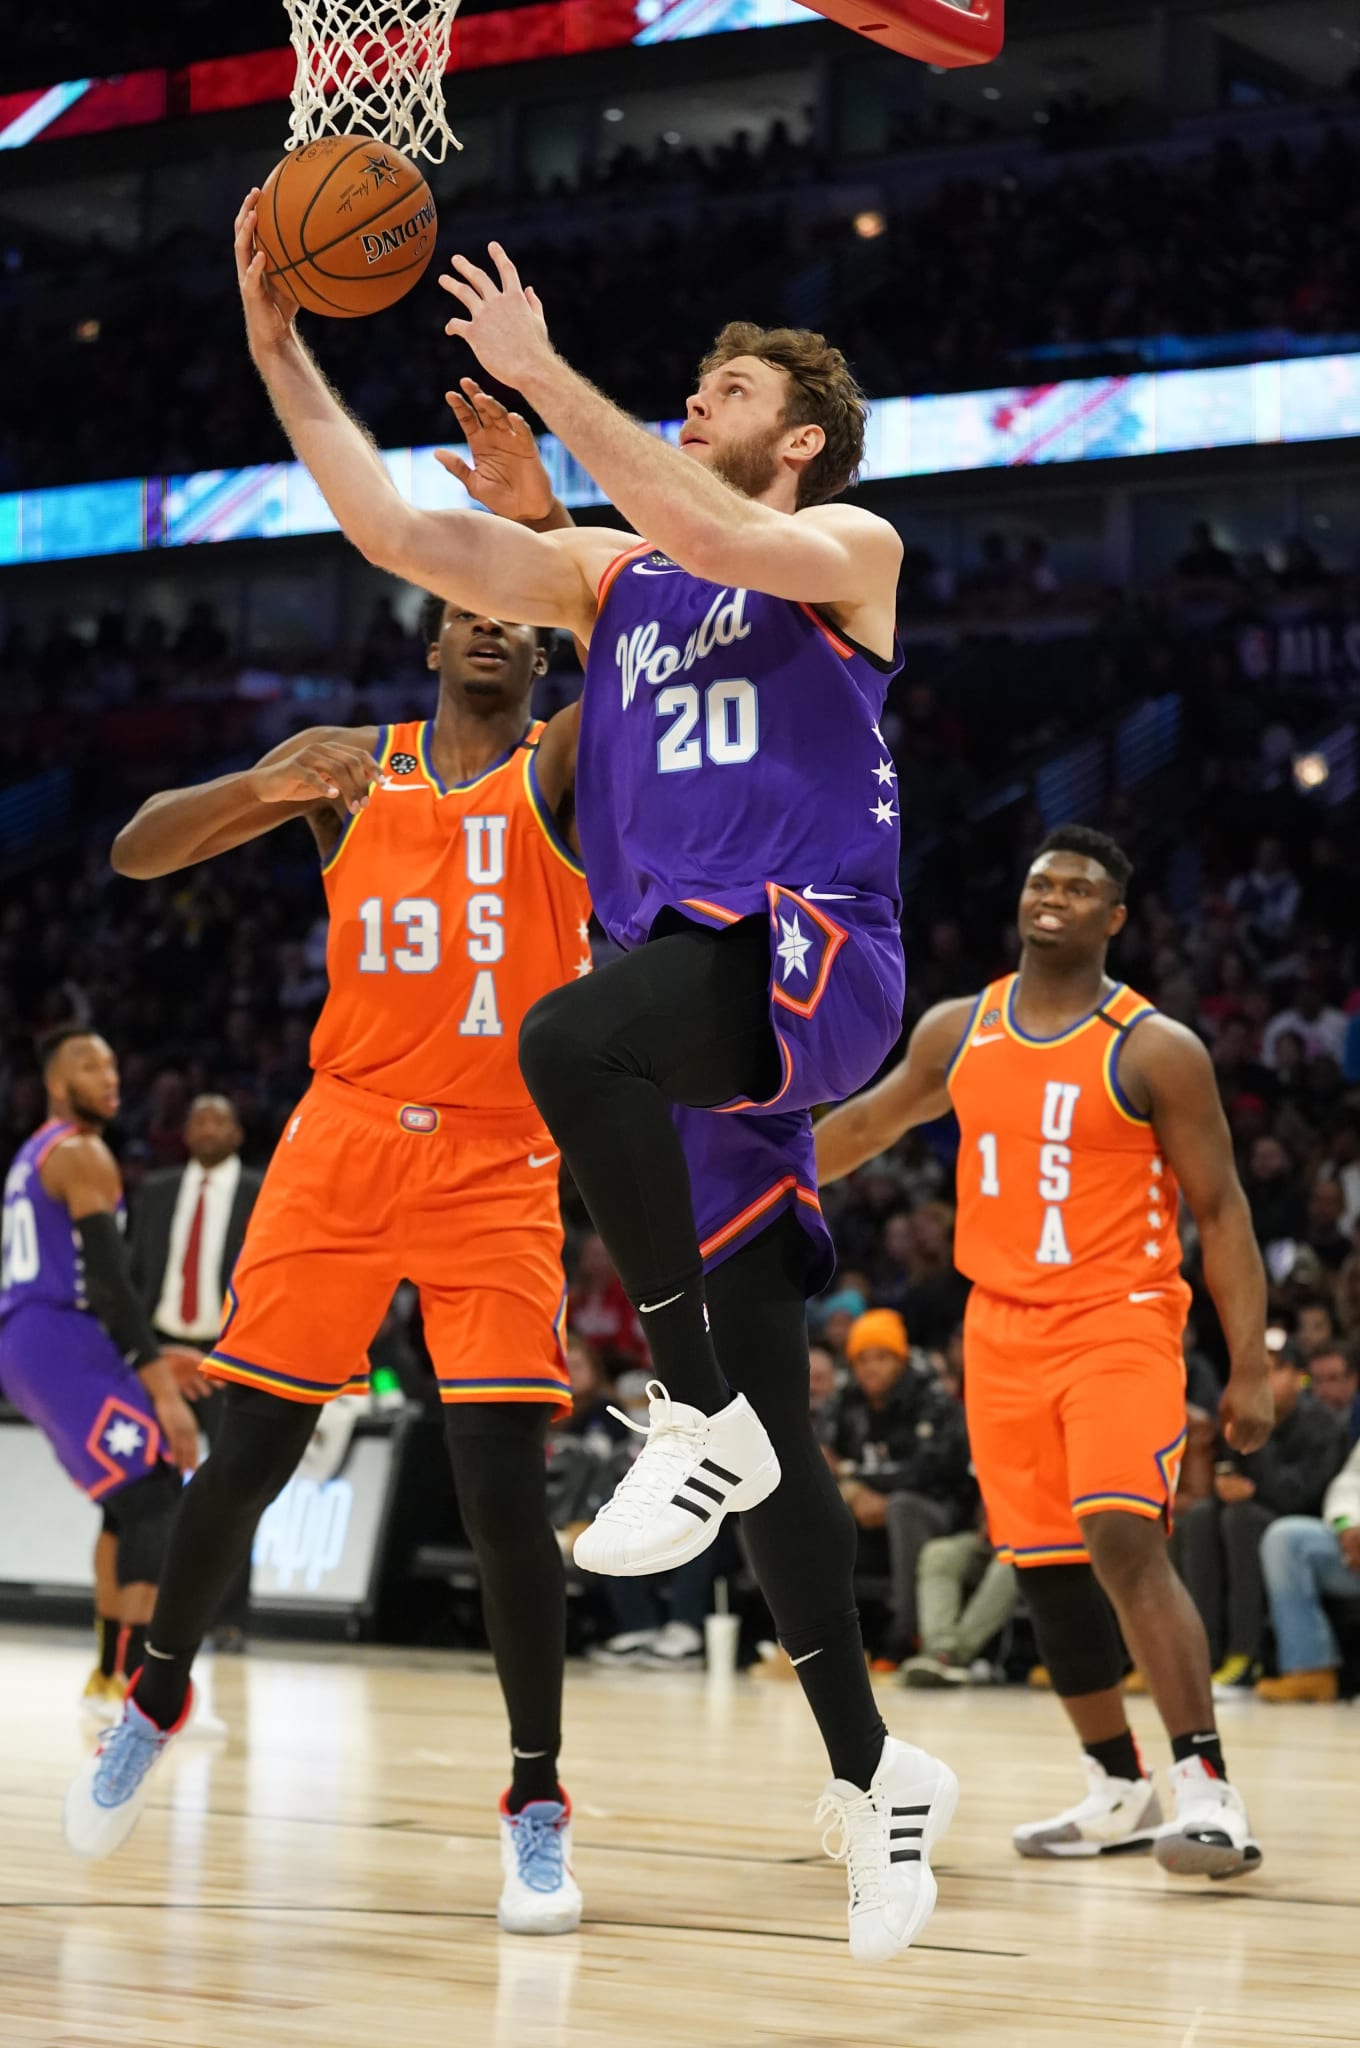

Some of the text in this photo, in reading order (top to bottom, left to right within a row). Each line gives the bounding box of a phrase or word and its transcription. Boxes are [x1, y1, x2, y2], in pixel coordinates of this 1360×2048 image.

[361, 195, 436, 265] PALDING
[615, 587, 751, 711] World
[655, 676, 759, 774] 20
[358, 897, 441, 974] 13
[459, 815, 508, 1037] USA
[977, 1132, 1000, 1197] 1
[1035, 1080, 1081, 1264] USA
